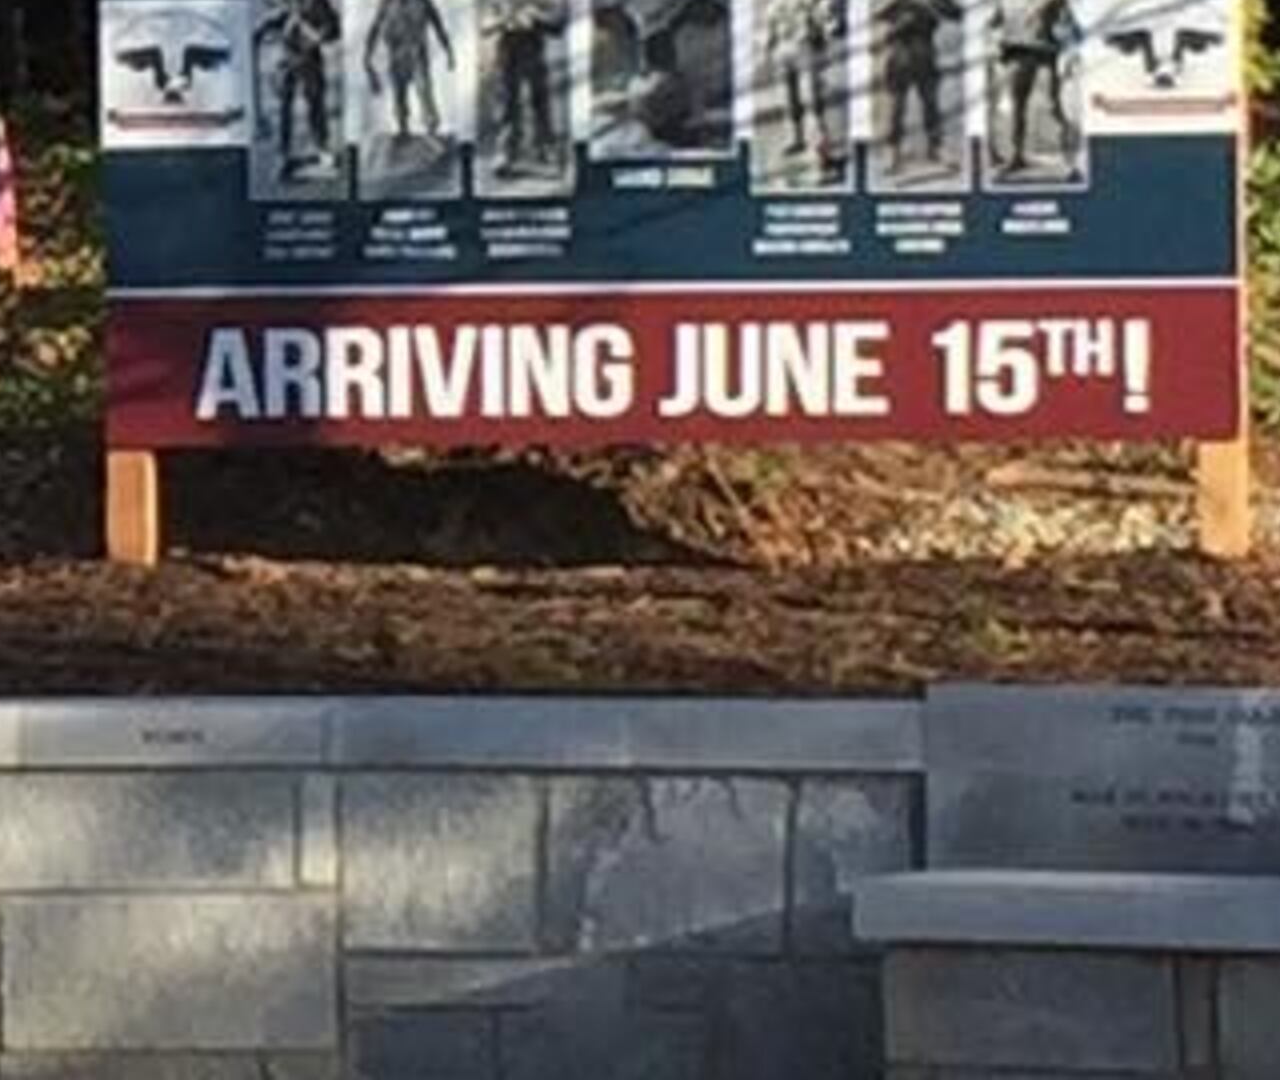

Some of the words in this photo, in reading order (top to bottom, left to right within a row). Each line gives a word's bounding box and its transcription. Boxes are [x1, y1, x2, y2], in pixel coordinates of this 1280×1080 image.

[195, 322, 634, 420] ARRIVING
[657, 321, 890, 417] JUNE
[930, 317, 1151, 415] 15TH!
